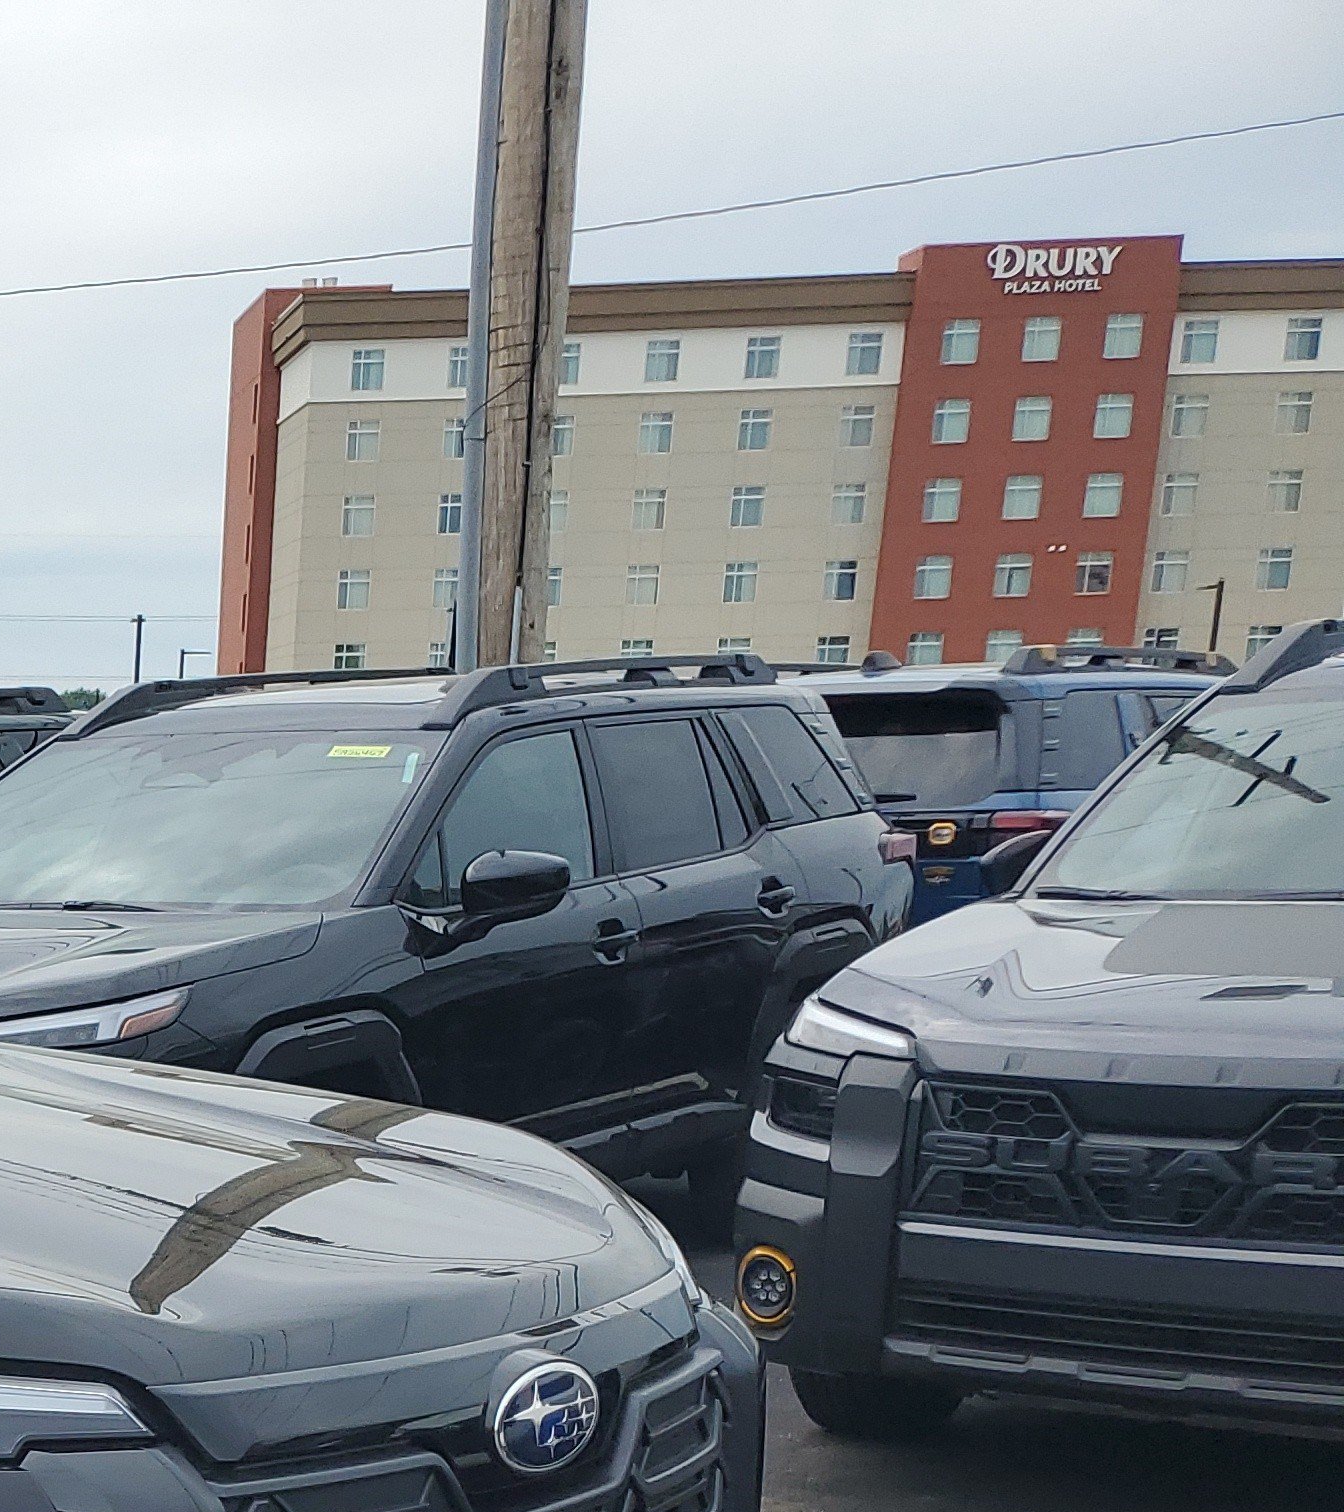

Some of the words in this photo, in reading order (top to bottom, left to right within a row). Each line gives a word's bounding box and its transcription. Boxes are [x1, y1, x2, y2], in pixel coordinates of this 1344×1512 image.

[987, 244, 1123, 279] DRURY
[1004, 280, 1051, 295] PLAZA
[1054, 278, 1102, 293] HOTEL
